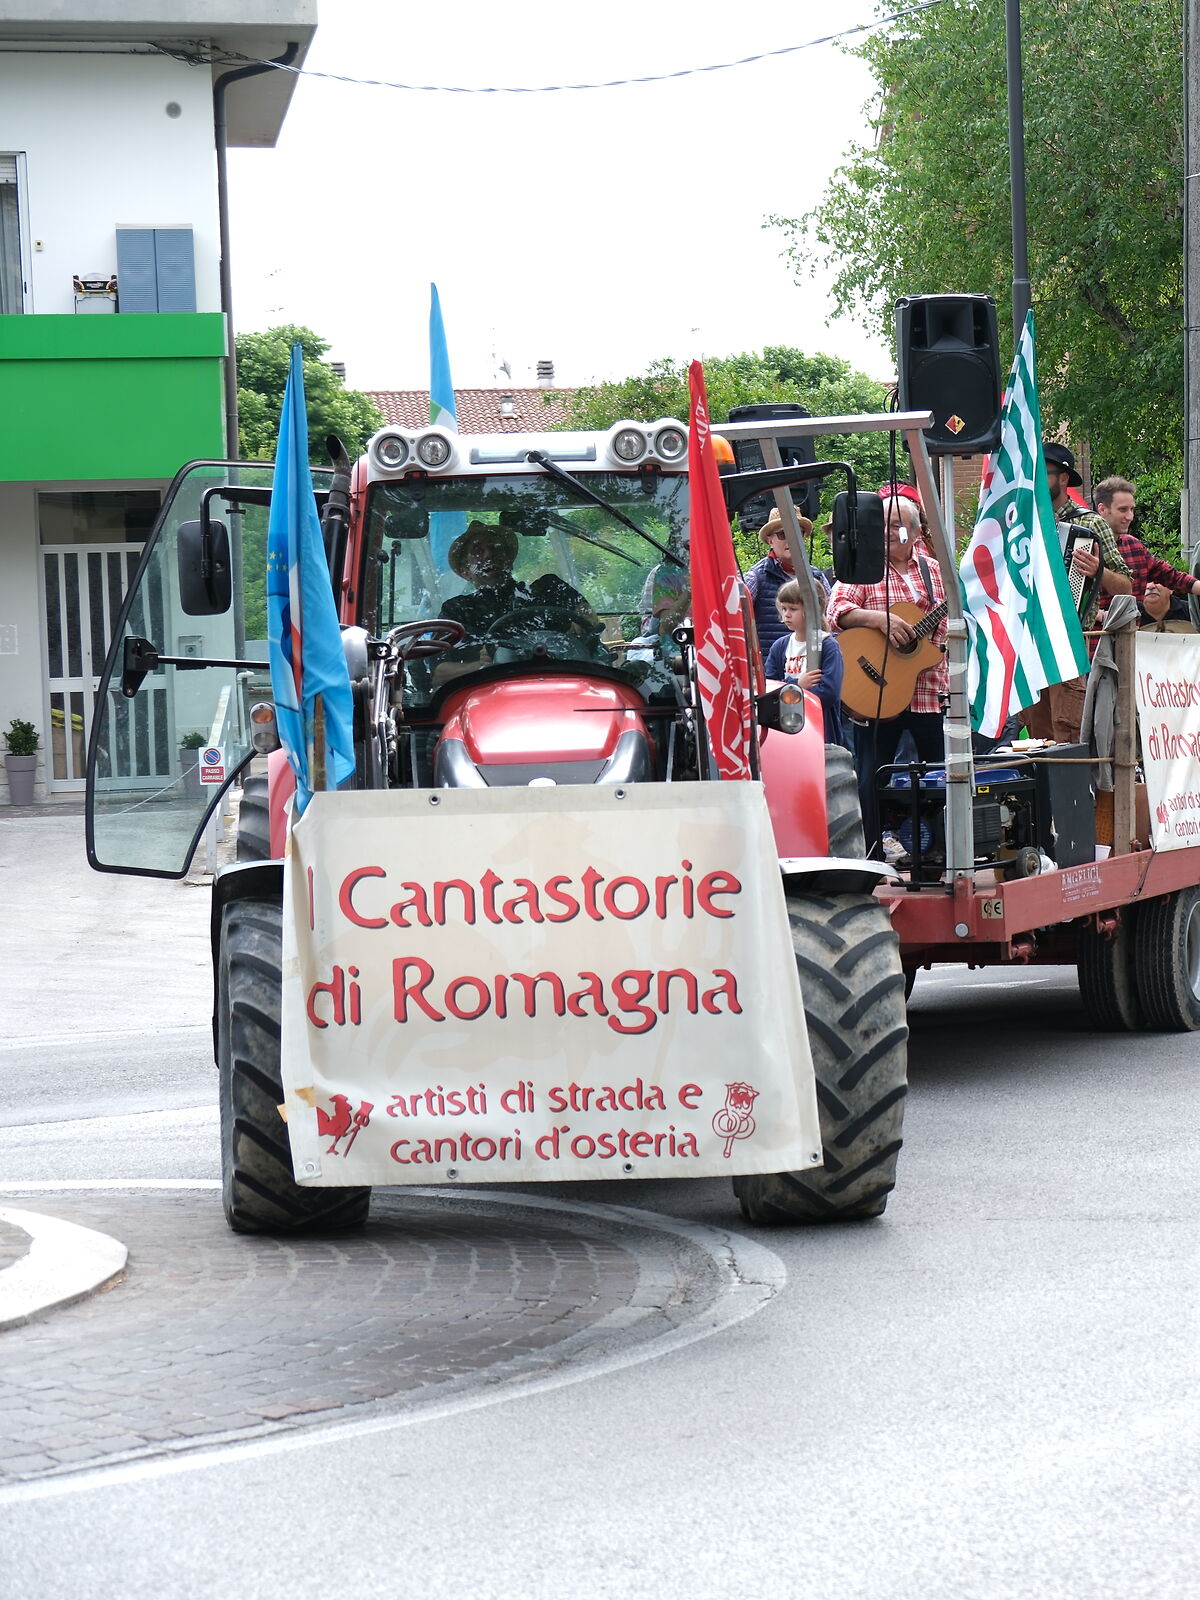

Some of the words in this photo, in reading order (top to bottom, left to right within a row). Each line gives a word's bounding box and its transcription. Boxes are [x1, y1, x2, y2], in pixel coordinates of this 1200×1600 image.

[1138, 672, 1147, 708] I
[1148, 725, 1161, 761] di
[1174, 817, 1199, 838] cantori
[307, 865, 315, 931] I
[338, 859, 743, 930] Cantastorie
[306, 964, 361, 1029] di
[392, 956, 744, 1036] Romagna
[386, 1082, 487, 1118] artisti
[500, 1080, 535, 1114] di
[548, 1077, 667, 1113] strada
[678, 1083, 703, 1110] e
[390, 1128, 522, 1165] cantori
